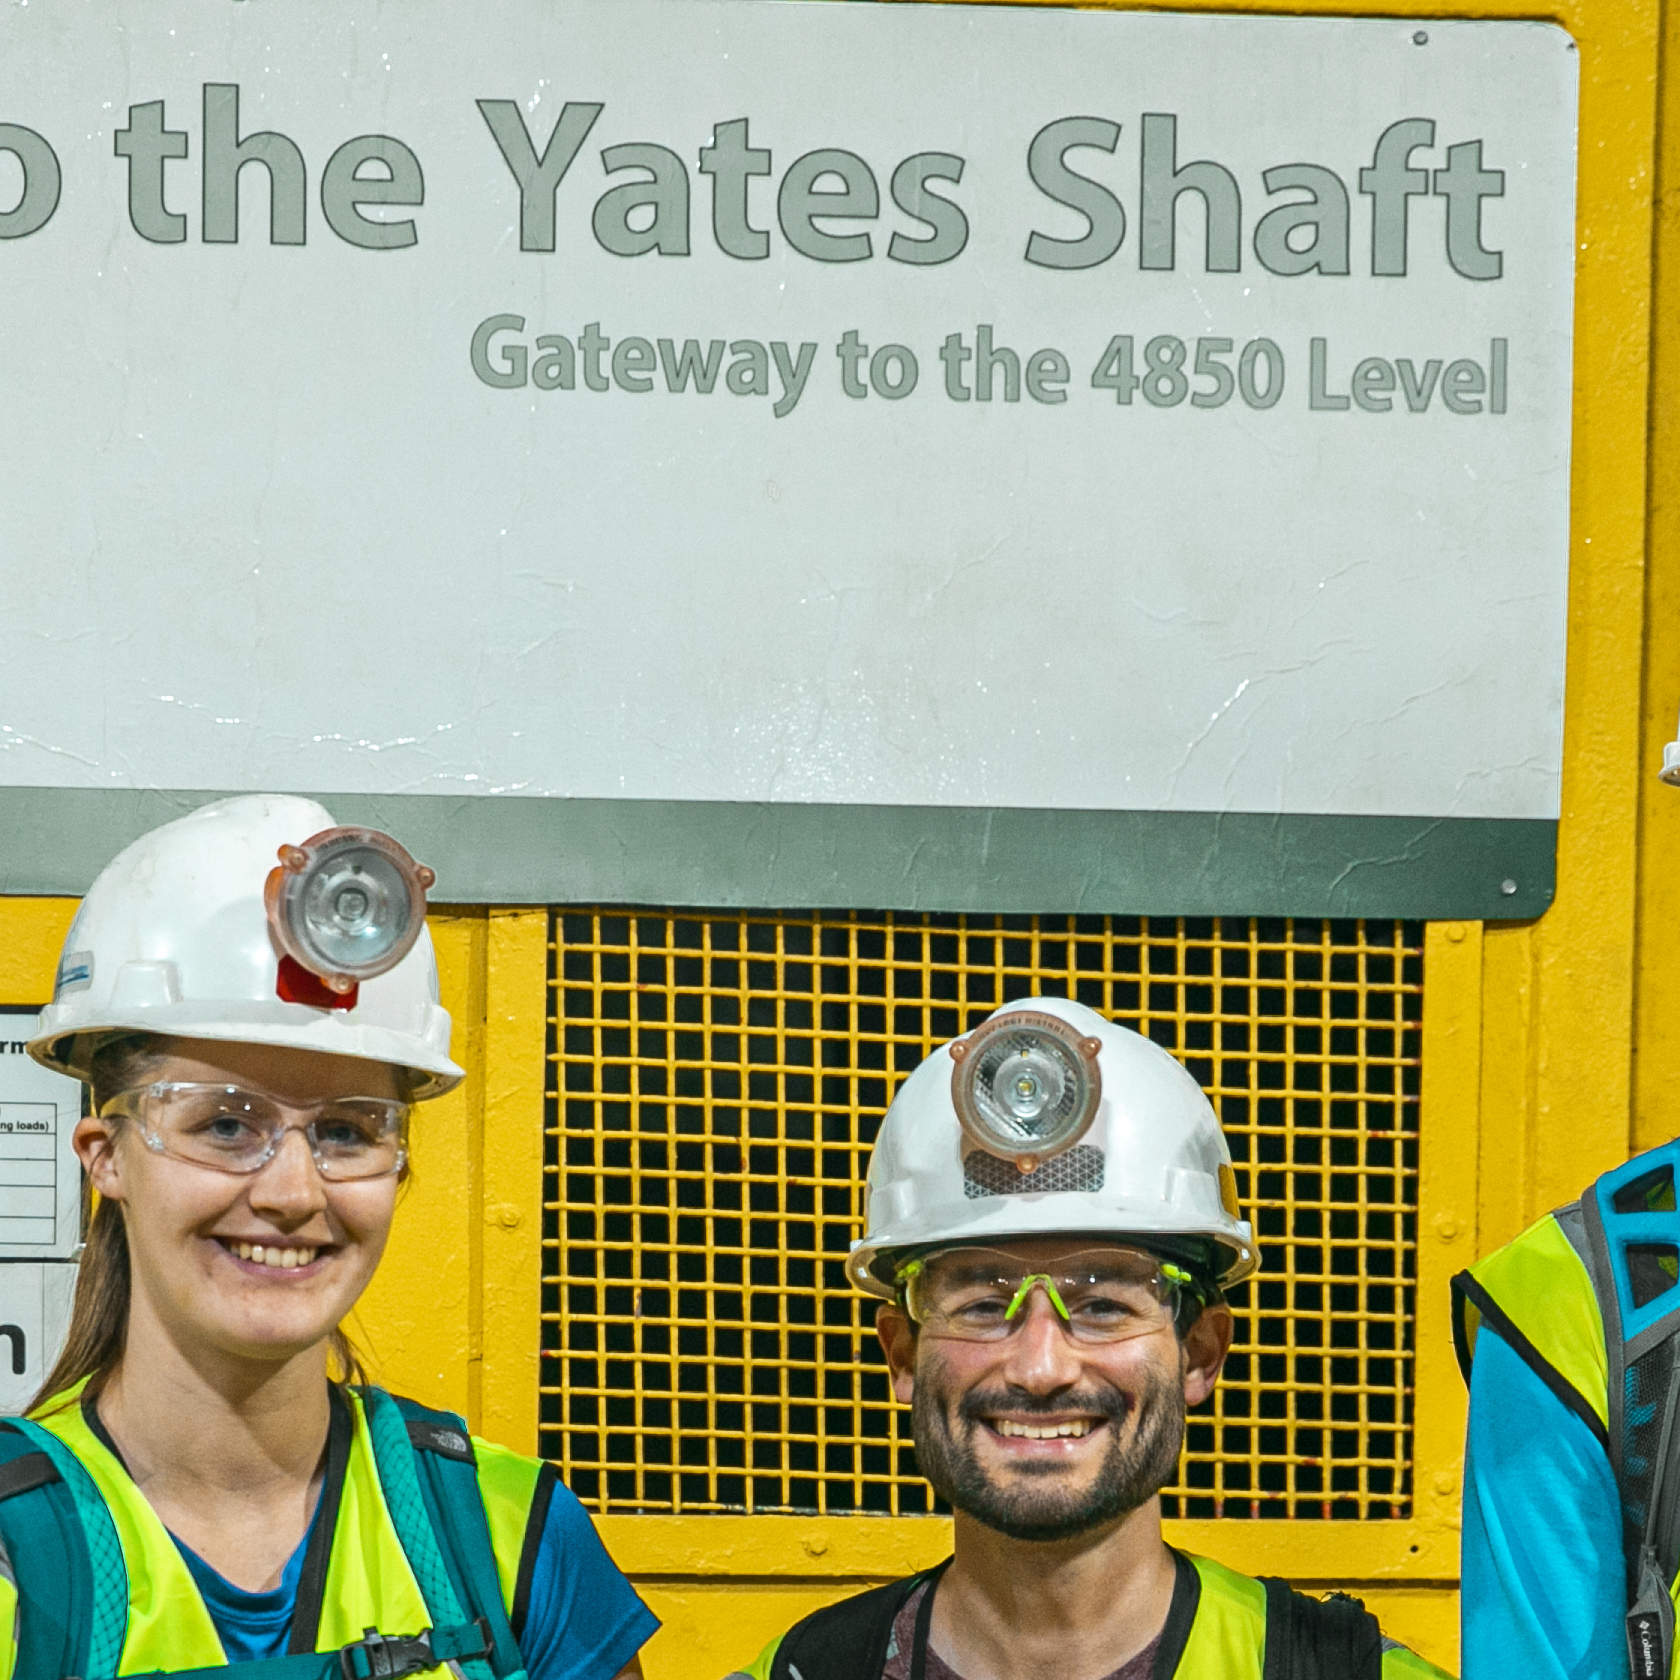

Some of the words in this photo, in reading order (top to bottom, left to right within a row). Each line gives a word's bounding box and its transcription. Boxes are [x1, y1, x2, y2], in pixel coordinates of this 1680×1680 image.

[114, 82, 427, 252] the
[476, 98, 972, 267] Yates
[1024, 112, 1506, 283] Shaft
[469, 313, 817, 419] Gateway
[836, 328, 917, 402] to
[938, 324, 1070, 406] the
[1090, 331, 1286, 412] 4850
[1308, 338, 1510, 416] Level
[16, 1121, 49, 1133] loads)
[1641, 1631, 1654, 1676] Columbia
